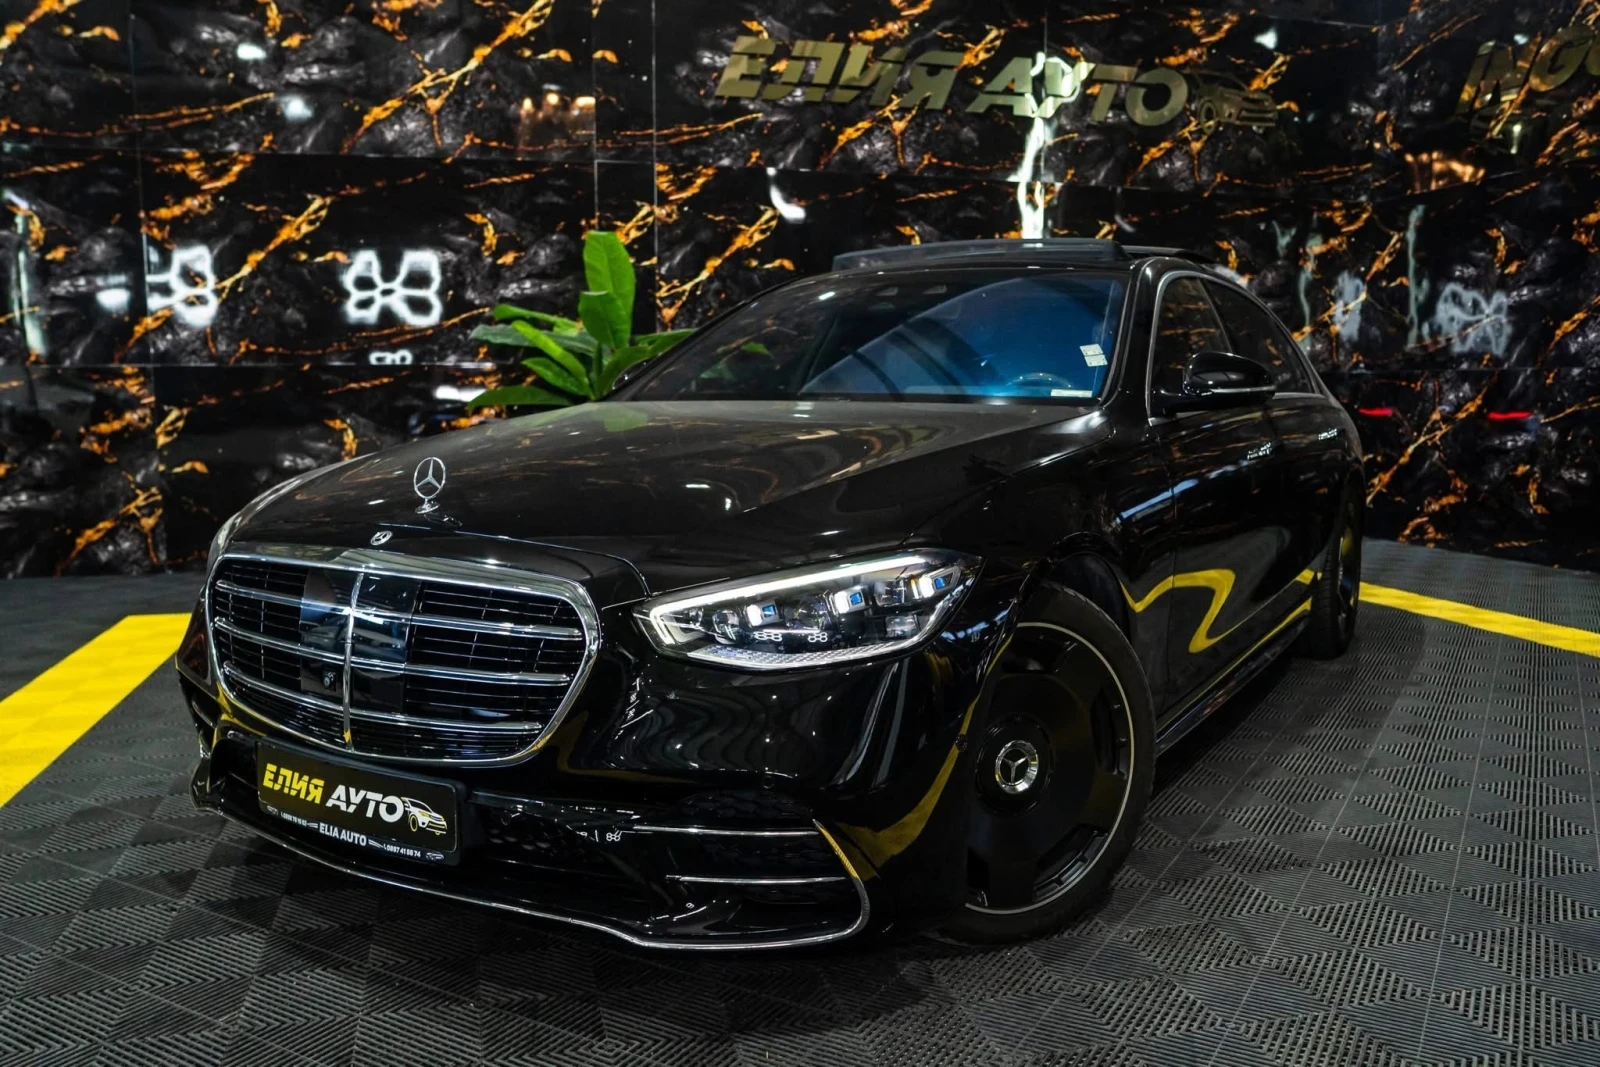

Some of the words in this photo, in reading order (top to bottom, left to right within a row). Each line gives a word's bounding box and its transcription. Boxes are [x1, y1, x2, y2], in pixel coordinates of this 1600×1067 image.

[714, 35, 963, 111] ЕЛИЯ
[966, 56, 1189, 127] АУТО
[263, 763, 325, 804] ЕЛИЯ
[325, 784, 404, 823] АУТО
[319, 822, 339, 839] ELIA
[340, 828, 367, 846] AUTO
